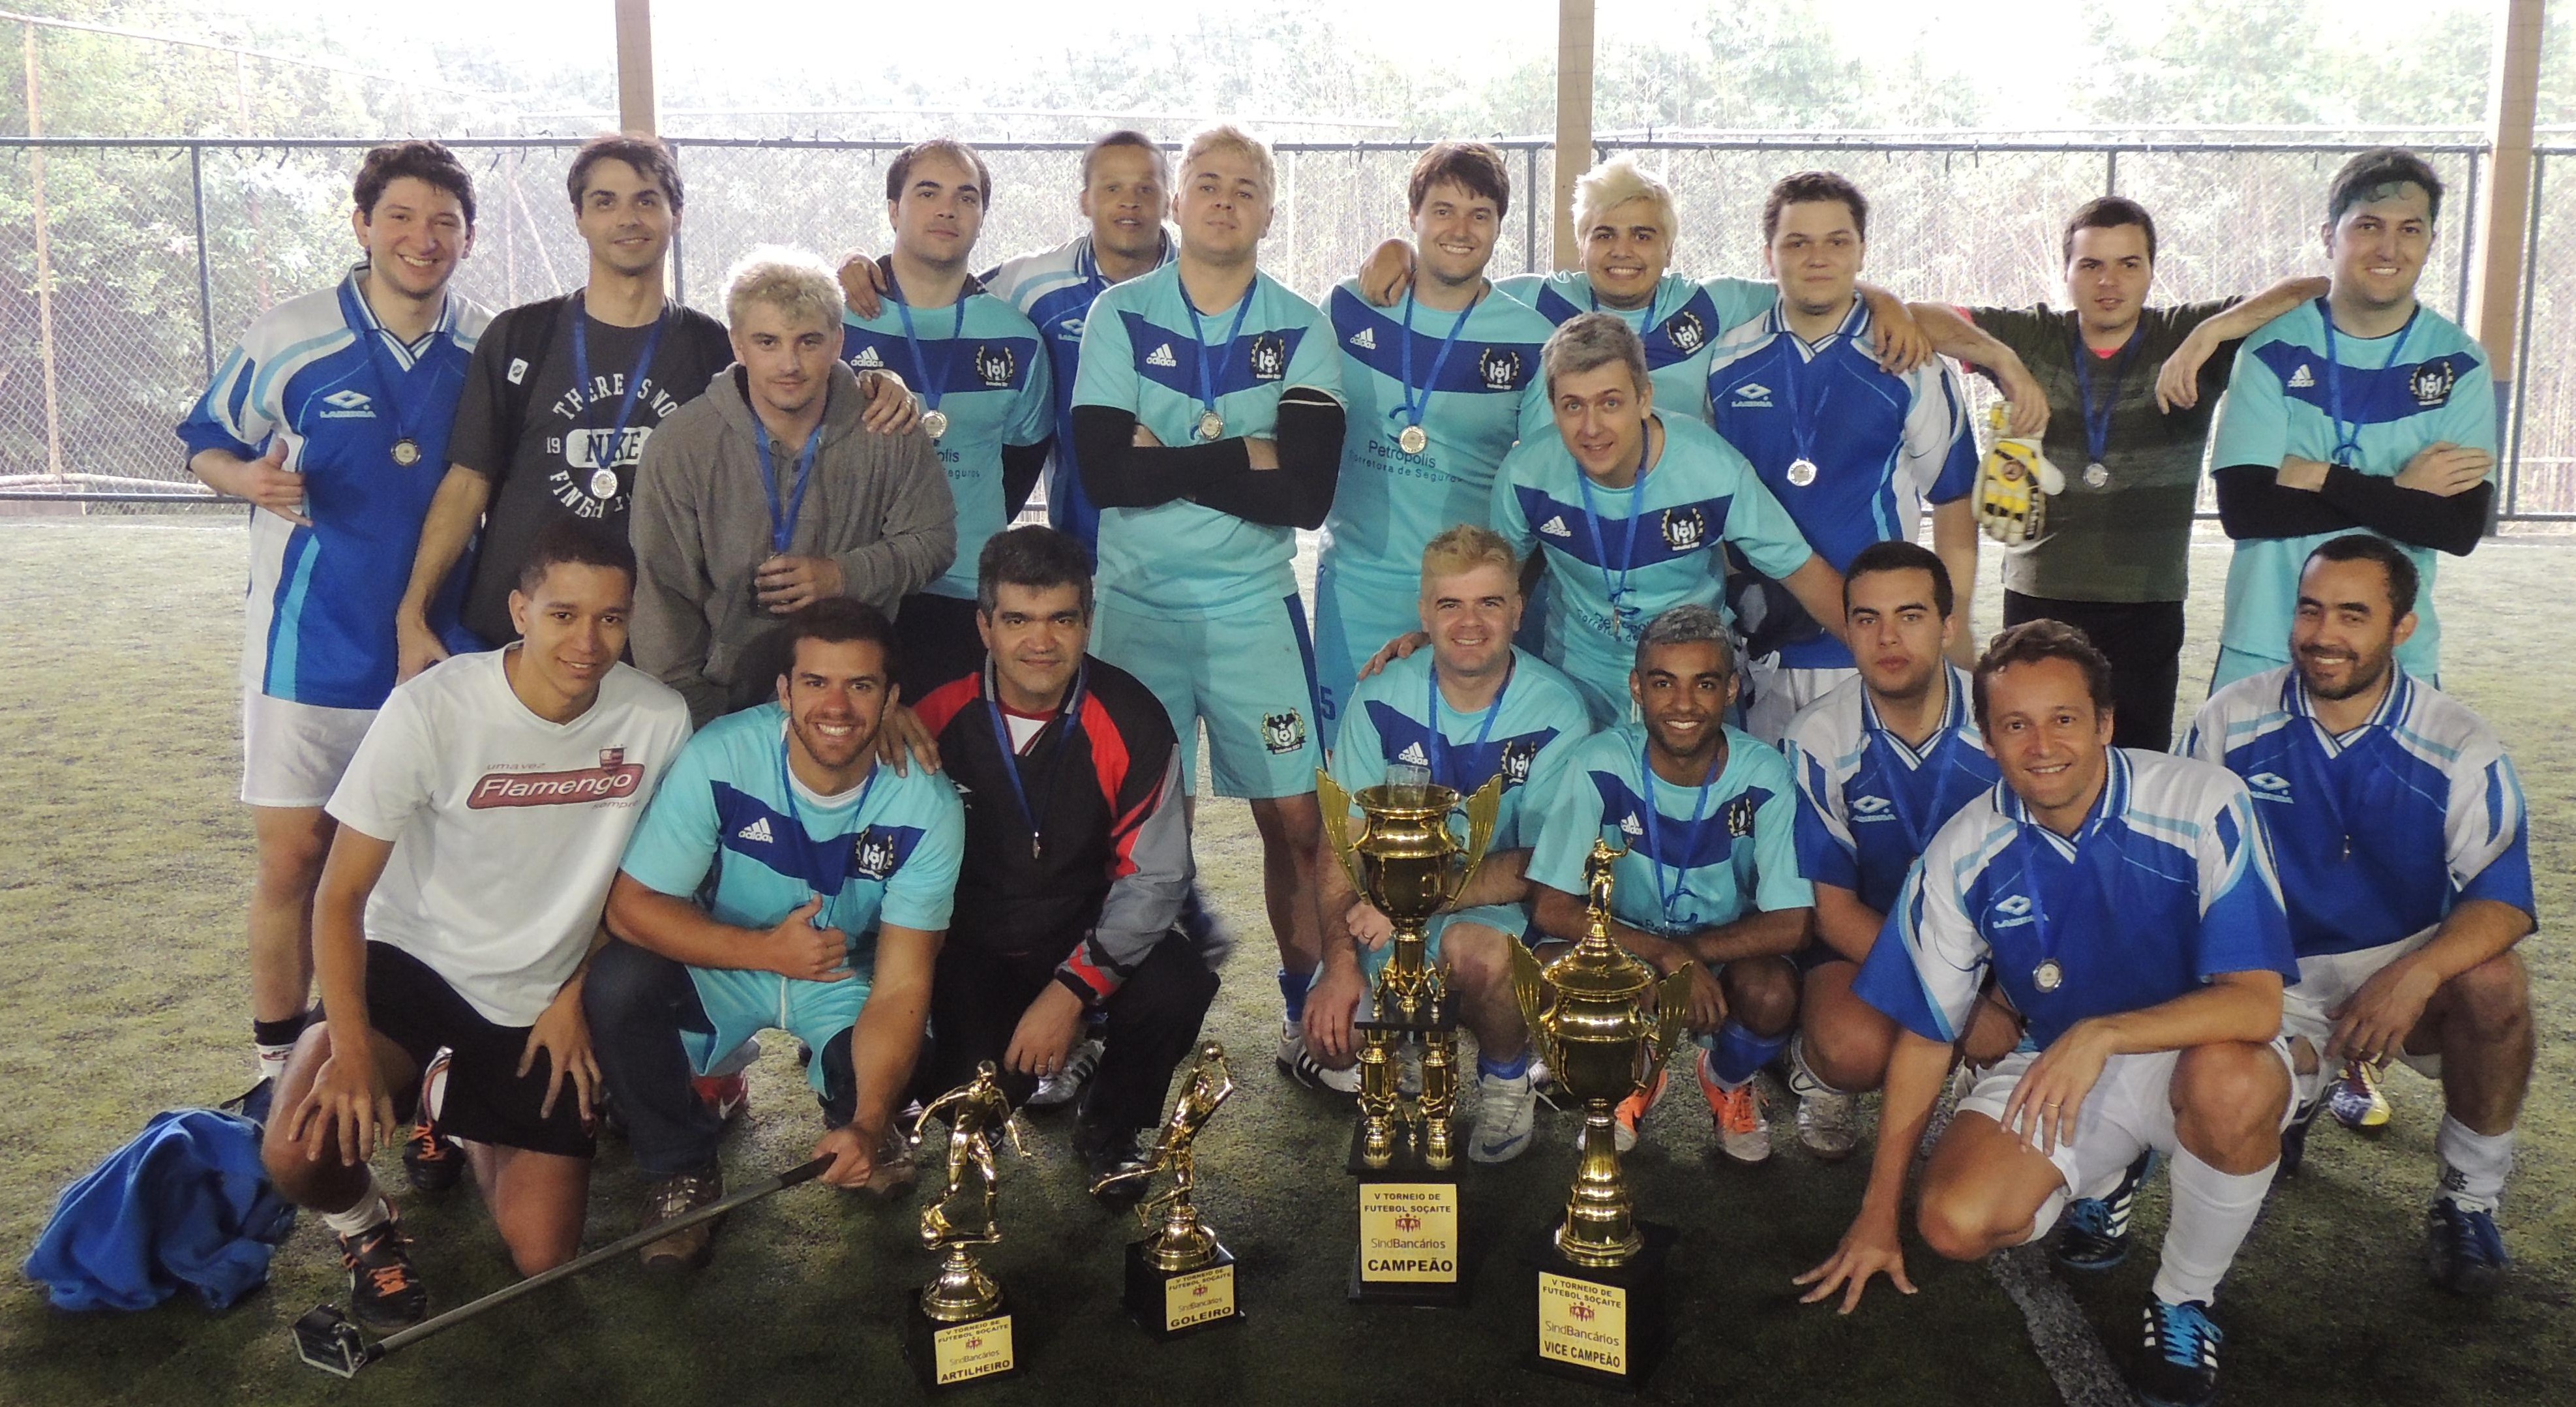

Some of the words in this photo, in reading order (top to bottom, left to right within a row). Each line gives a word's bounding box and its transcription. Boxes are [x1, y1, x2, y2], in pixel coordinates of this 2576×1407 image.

[1349, 337, 1376, 350] adidas
[850, 359, 884, 367] adidas
[1146, 356, 1176, 367] adidas
[650, 387, 678, 418] NO
[547, 436, 561, 454] 19
[1398, 466, 1411, 476] de
[1319, 685, 1336, 720] 5
[478, 773, 632, 798] Flamengo
[1371, 1238, 1446, 1248] SindBancários
[1368, 1257, 1453, 1272] CAMPEÃO
[1183, 1271, 1214, 1282] TORNEIO
[1169, 1280, 1200, 1291] FUTEBOL
[1561, 1280, 1598, 1294] TORNEIO
[1600, 1289, 1612, 1297] DE
[1543, 1286, 1581, 1300] FUTEBOL
[1584, 1294, 1621, 1309] SOÇAITE
[1171, 1307, 1231, 1327] GOLEIRO
[938, 1332, 973, 1344] FUTEBOL
[976, 1324, 1009, 1335] SOÇAITE
[954, 1322, 988, 1333] TORNEIO
[1545, 1320, 1619, 1346] SindBancários
[1544, 1340, 1568, 1356] VICE
[1570, 1346, 1620, 1368] CAMPEÃO
[941, 1359, 1010, 1382] ARTILHEIRO
